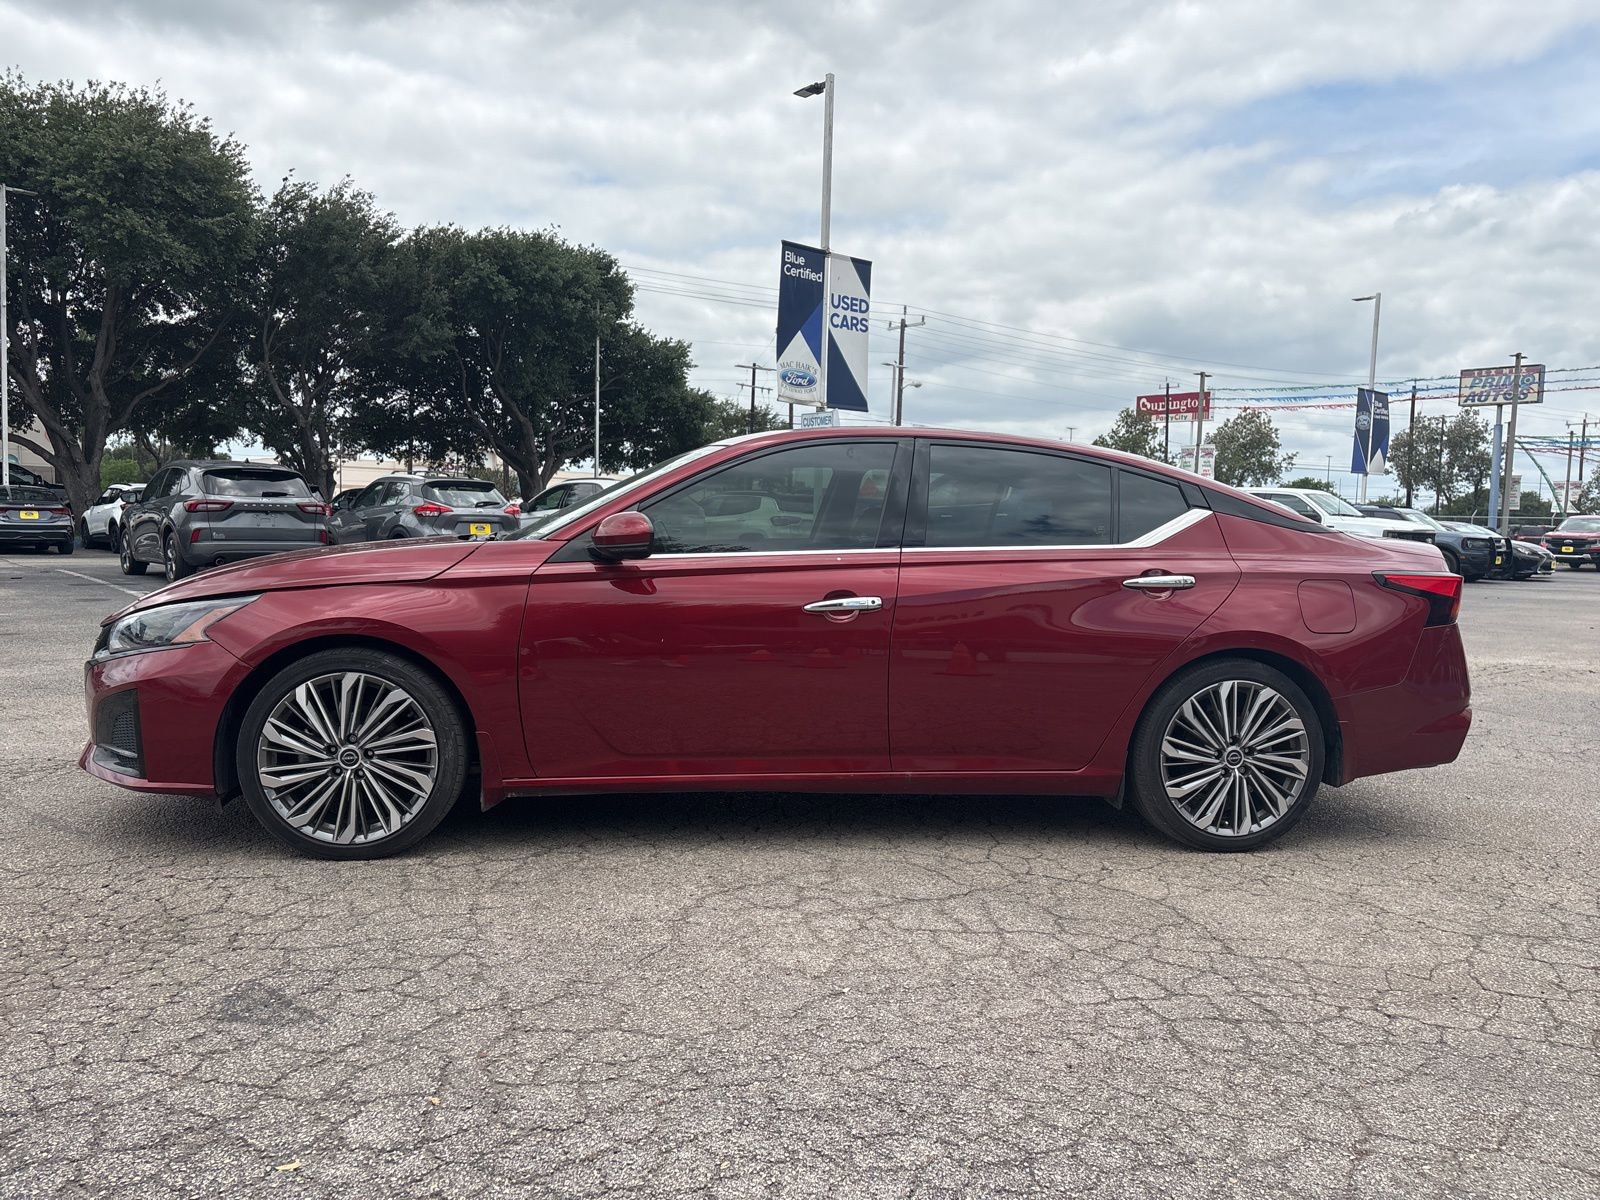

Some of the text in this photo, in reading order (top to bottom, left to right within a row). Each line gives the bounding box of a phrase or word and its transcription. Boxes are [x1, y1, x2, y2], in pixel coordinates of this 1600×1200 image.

[785, 251, 805, 265] Blue
[784, 264, 823, 282] Certified
[831, 293, 870, 314] USED
[830, 312, 869, 333] CARS
[780, 361, 794, 369] MAC
[1474, 367, 1528, 377] TEX MX
[785, 371, 809, 386] Ford
[1469, 373, 1536, 390] PRIMO
[1463, 387, 1529, 403] AUTOS
[802, 415, 832, 427] CUSTOMER
